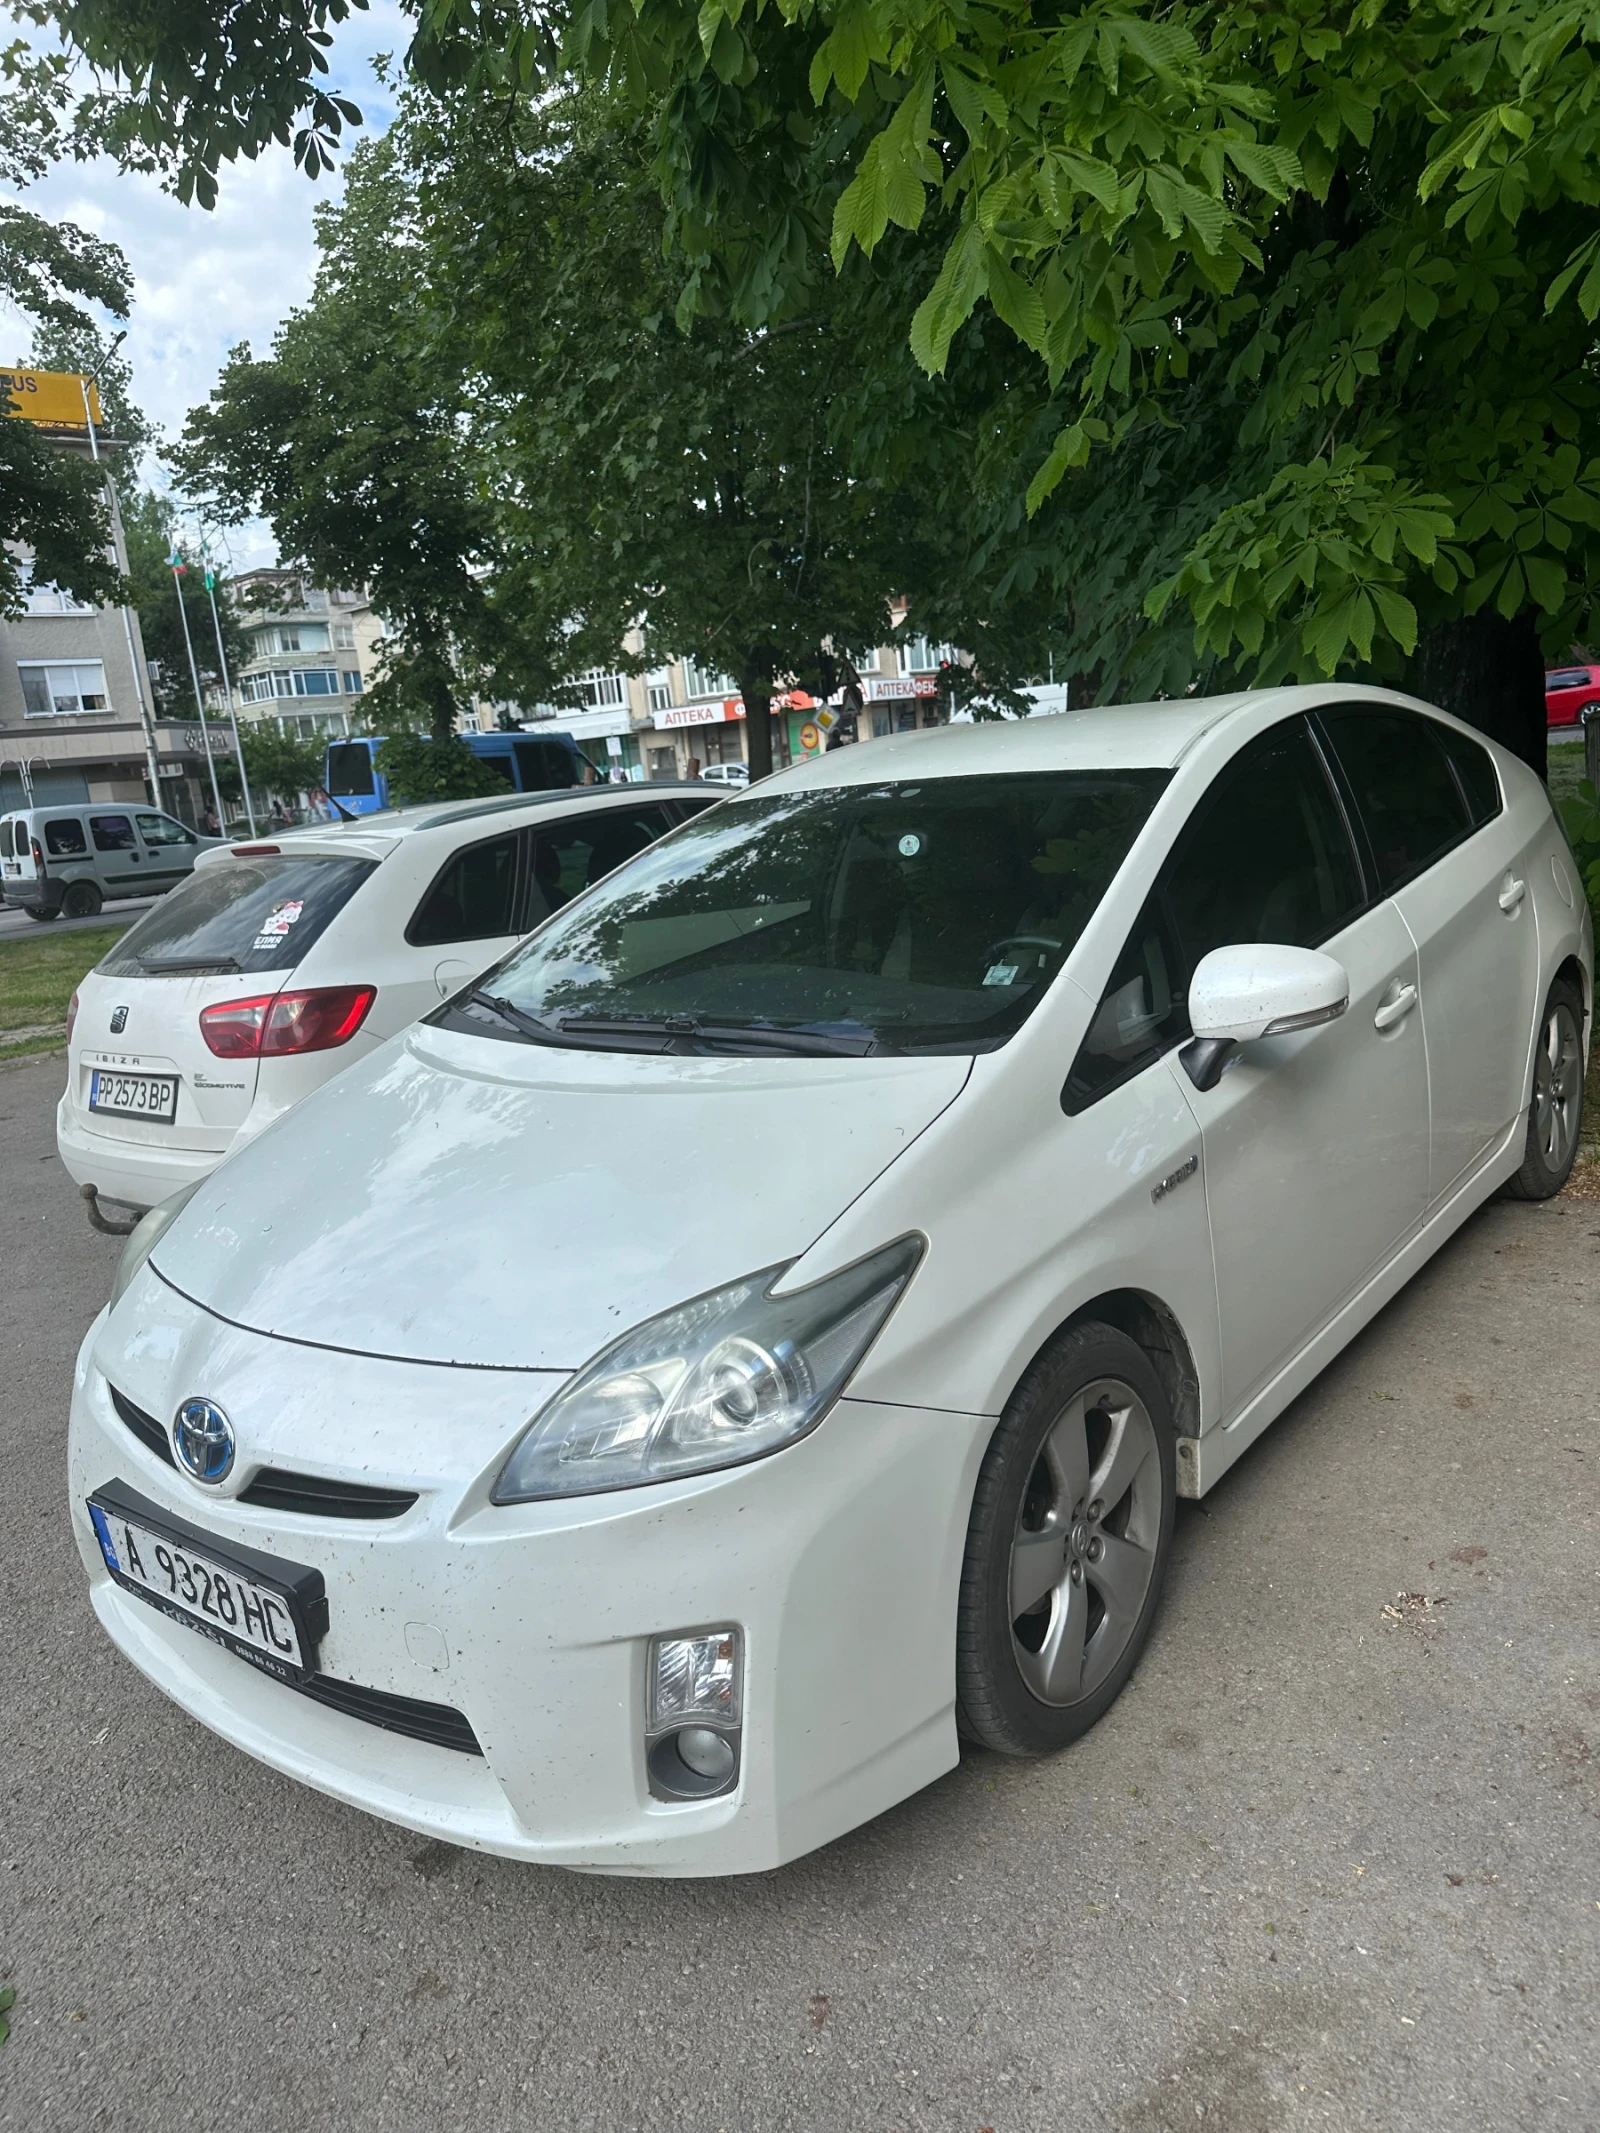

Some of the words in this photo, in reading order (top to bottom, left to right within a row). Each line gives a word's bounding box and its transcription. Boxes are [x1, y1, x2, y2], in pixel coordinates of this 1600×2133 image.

[3, 374, 37, 393] US
[876, 681, 915, 697] АПТЕКА
[915, 679, 938, 695] ФЕН
[665, 707, 714, 726] АПТЕКА
[96, 1054, 141, 1066] IBIZA
